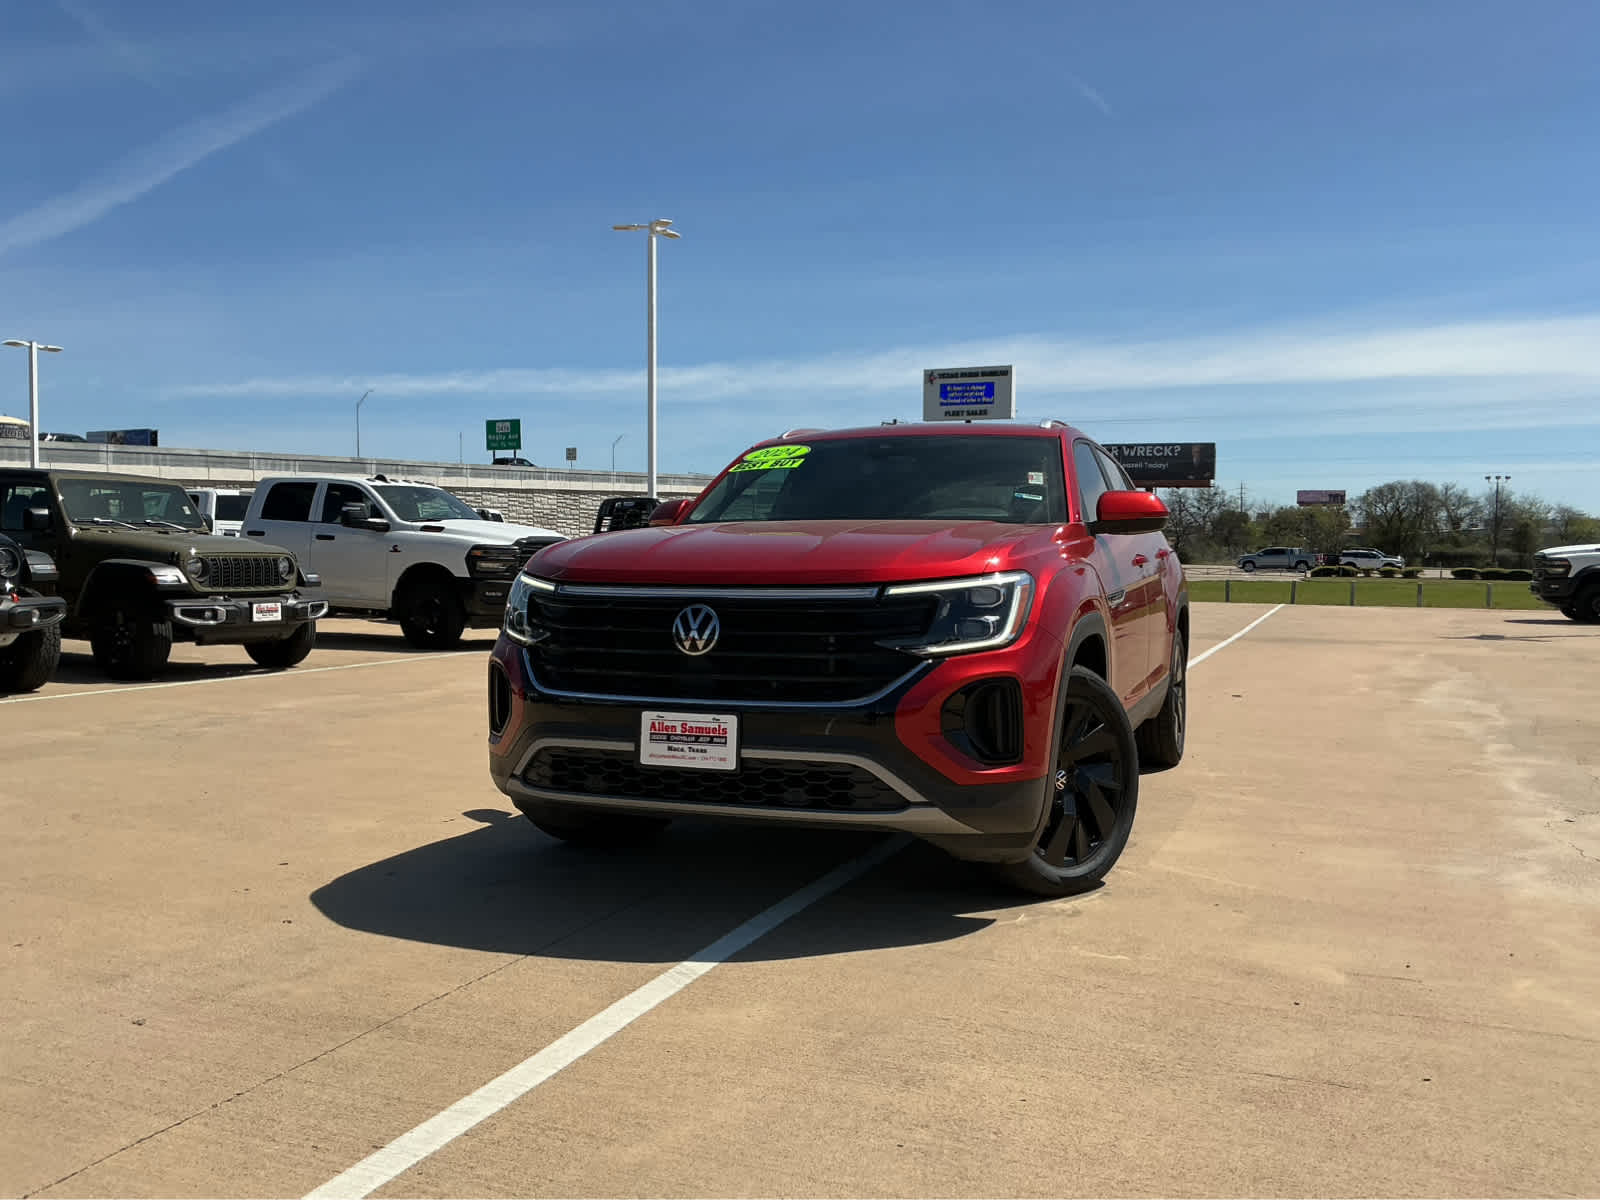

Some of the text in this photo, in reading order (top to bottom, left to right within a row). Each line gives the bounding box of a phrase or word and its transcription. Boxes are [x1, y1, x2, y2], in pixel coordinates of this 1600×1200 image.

[752, 447, 802, 459] 2024
[1123, 445, 1181, 456] WRECK?
[734, 458, 800, 470] BEST BUY
[649, 721, 728, 736] Allen Samuels
[688, 746, 707, 754] Texas
